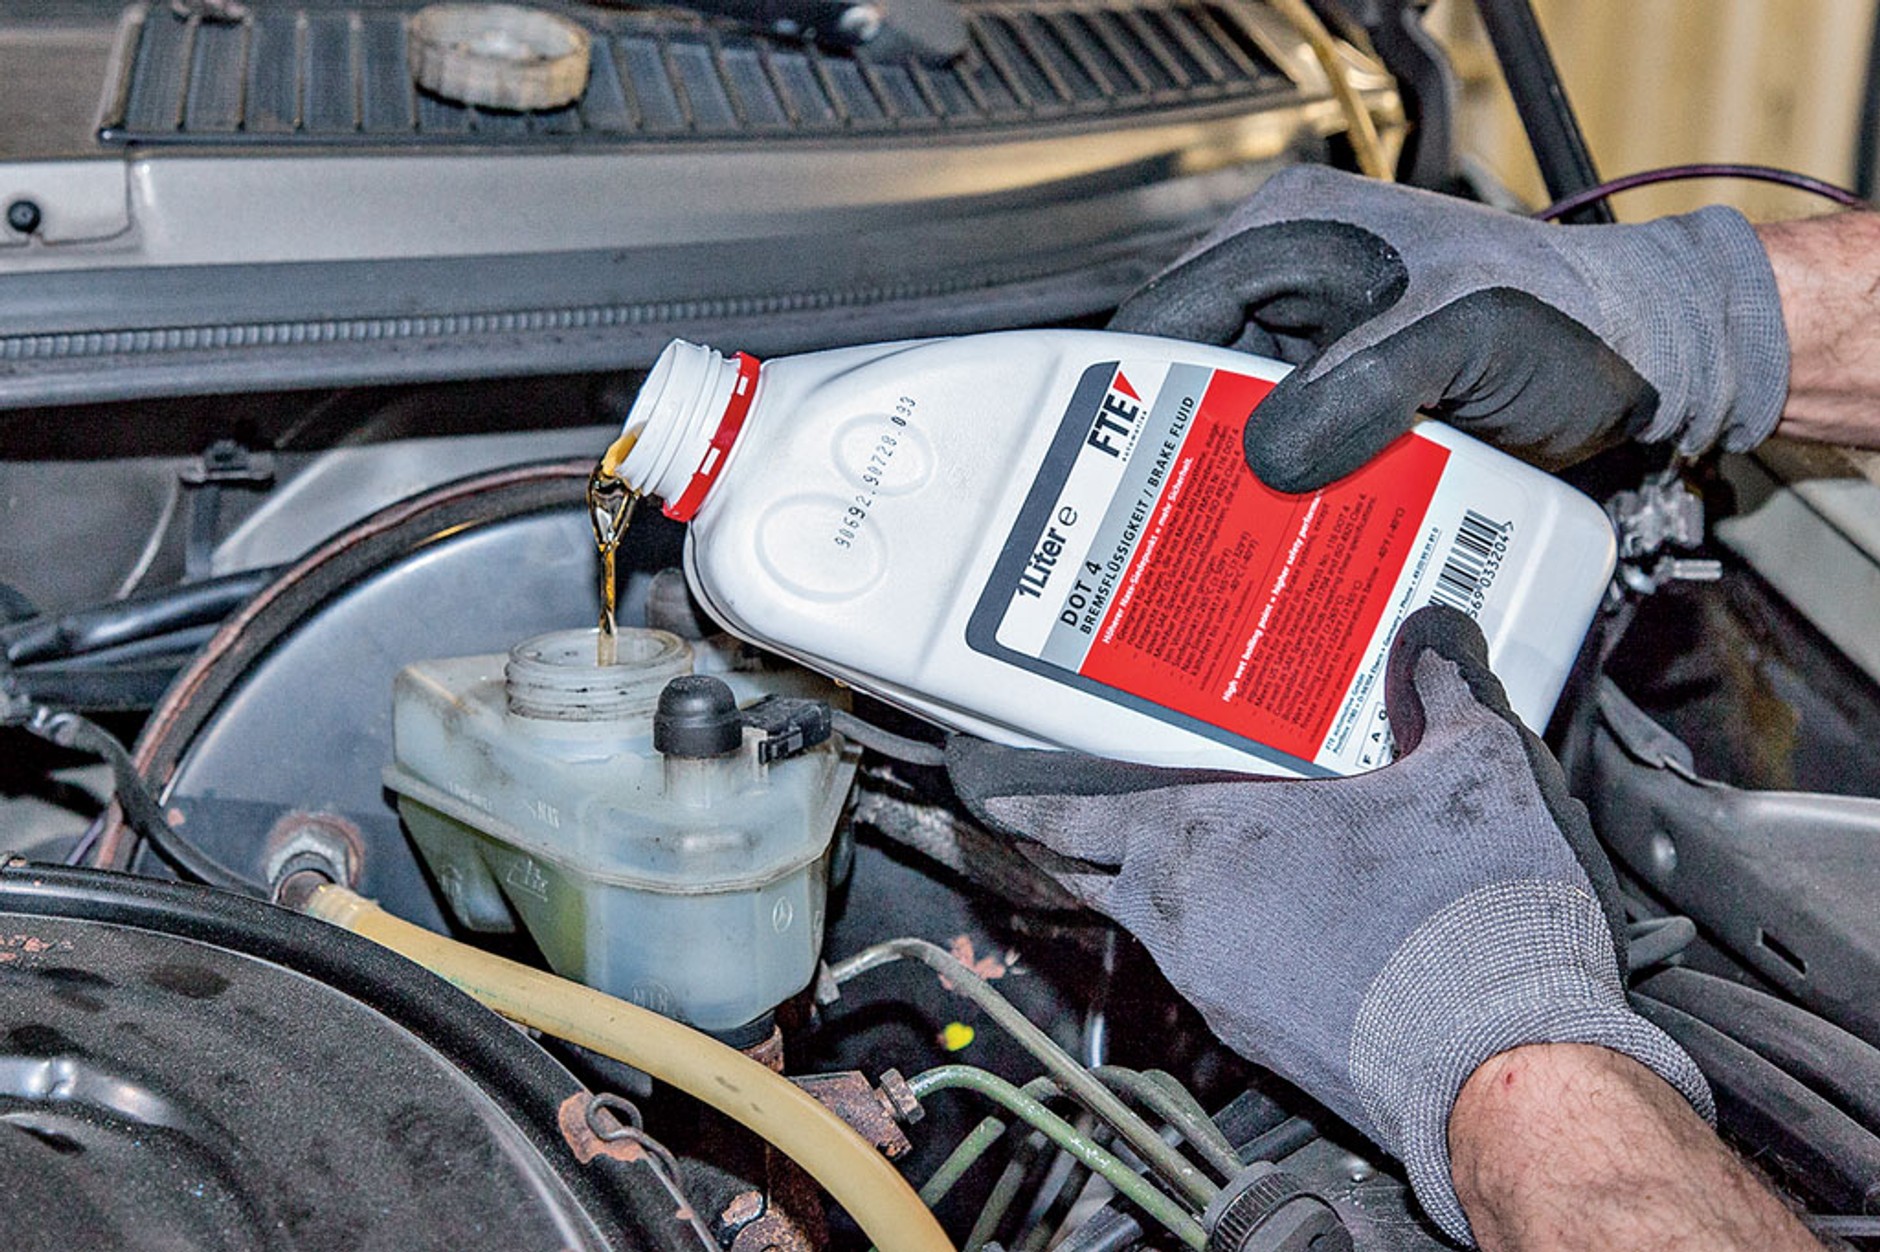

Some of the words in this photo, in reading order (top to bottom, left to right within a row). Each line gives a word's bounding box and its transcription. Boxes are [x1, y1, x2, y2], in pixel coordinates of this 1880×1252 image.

[1086, 393, 1139, 457] FTE
[1078, 498, 1149, 635] BREMSFLÜSSIGKEIT
[1146, 439, 1175, 487] BRAKE
[1169, 395, 1195, 437] FLUID
[1157, 502, 1173, 526] mehr
[1478, 532, 1510, 588] 033204
[1059, 579, 1093, 627] DOT
[1082, 558, 1103, 577] 4
